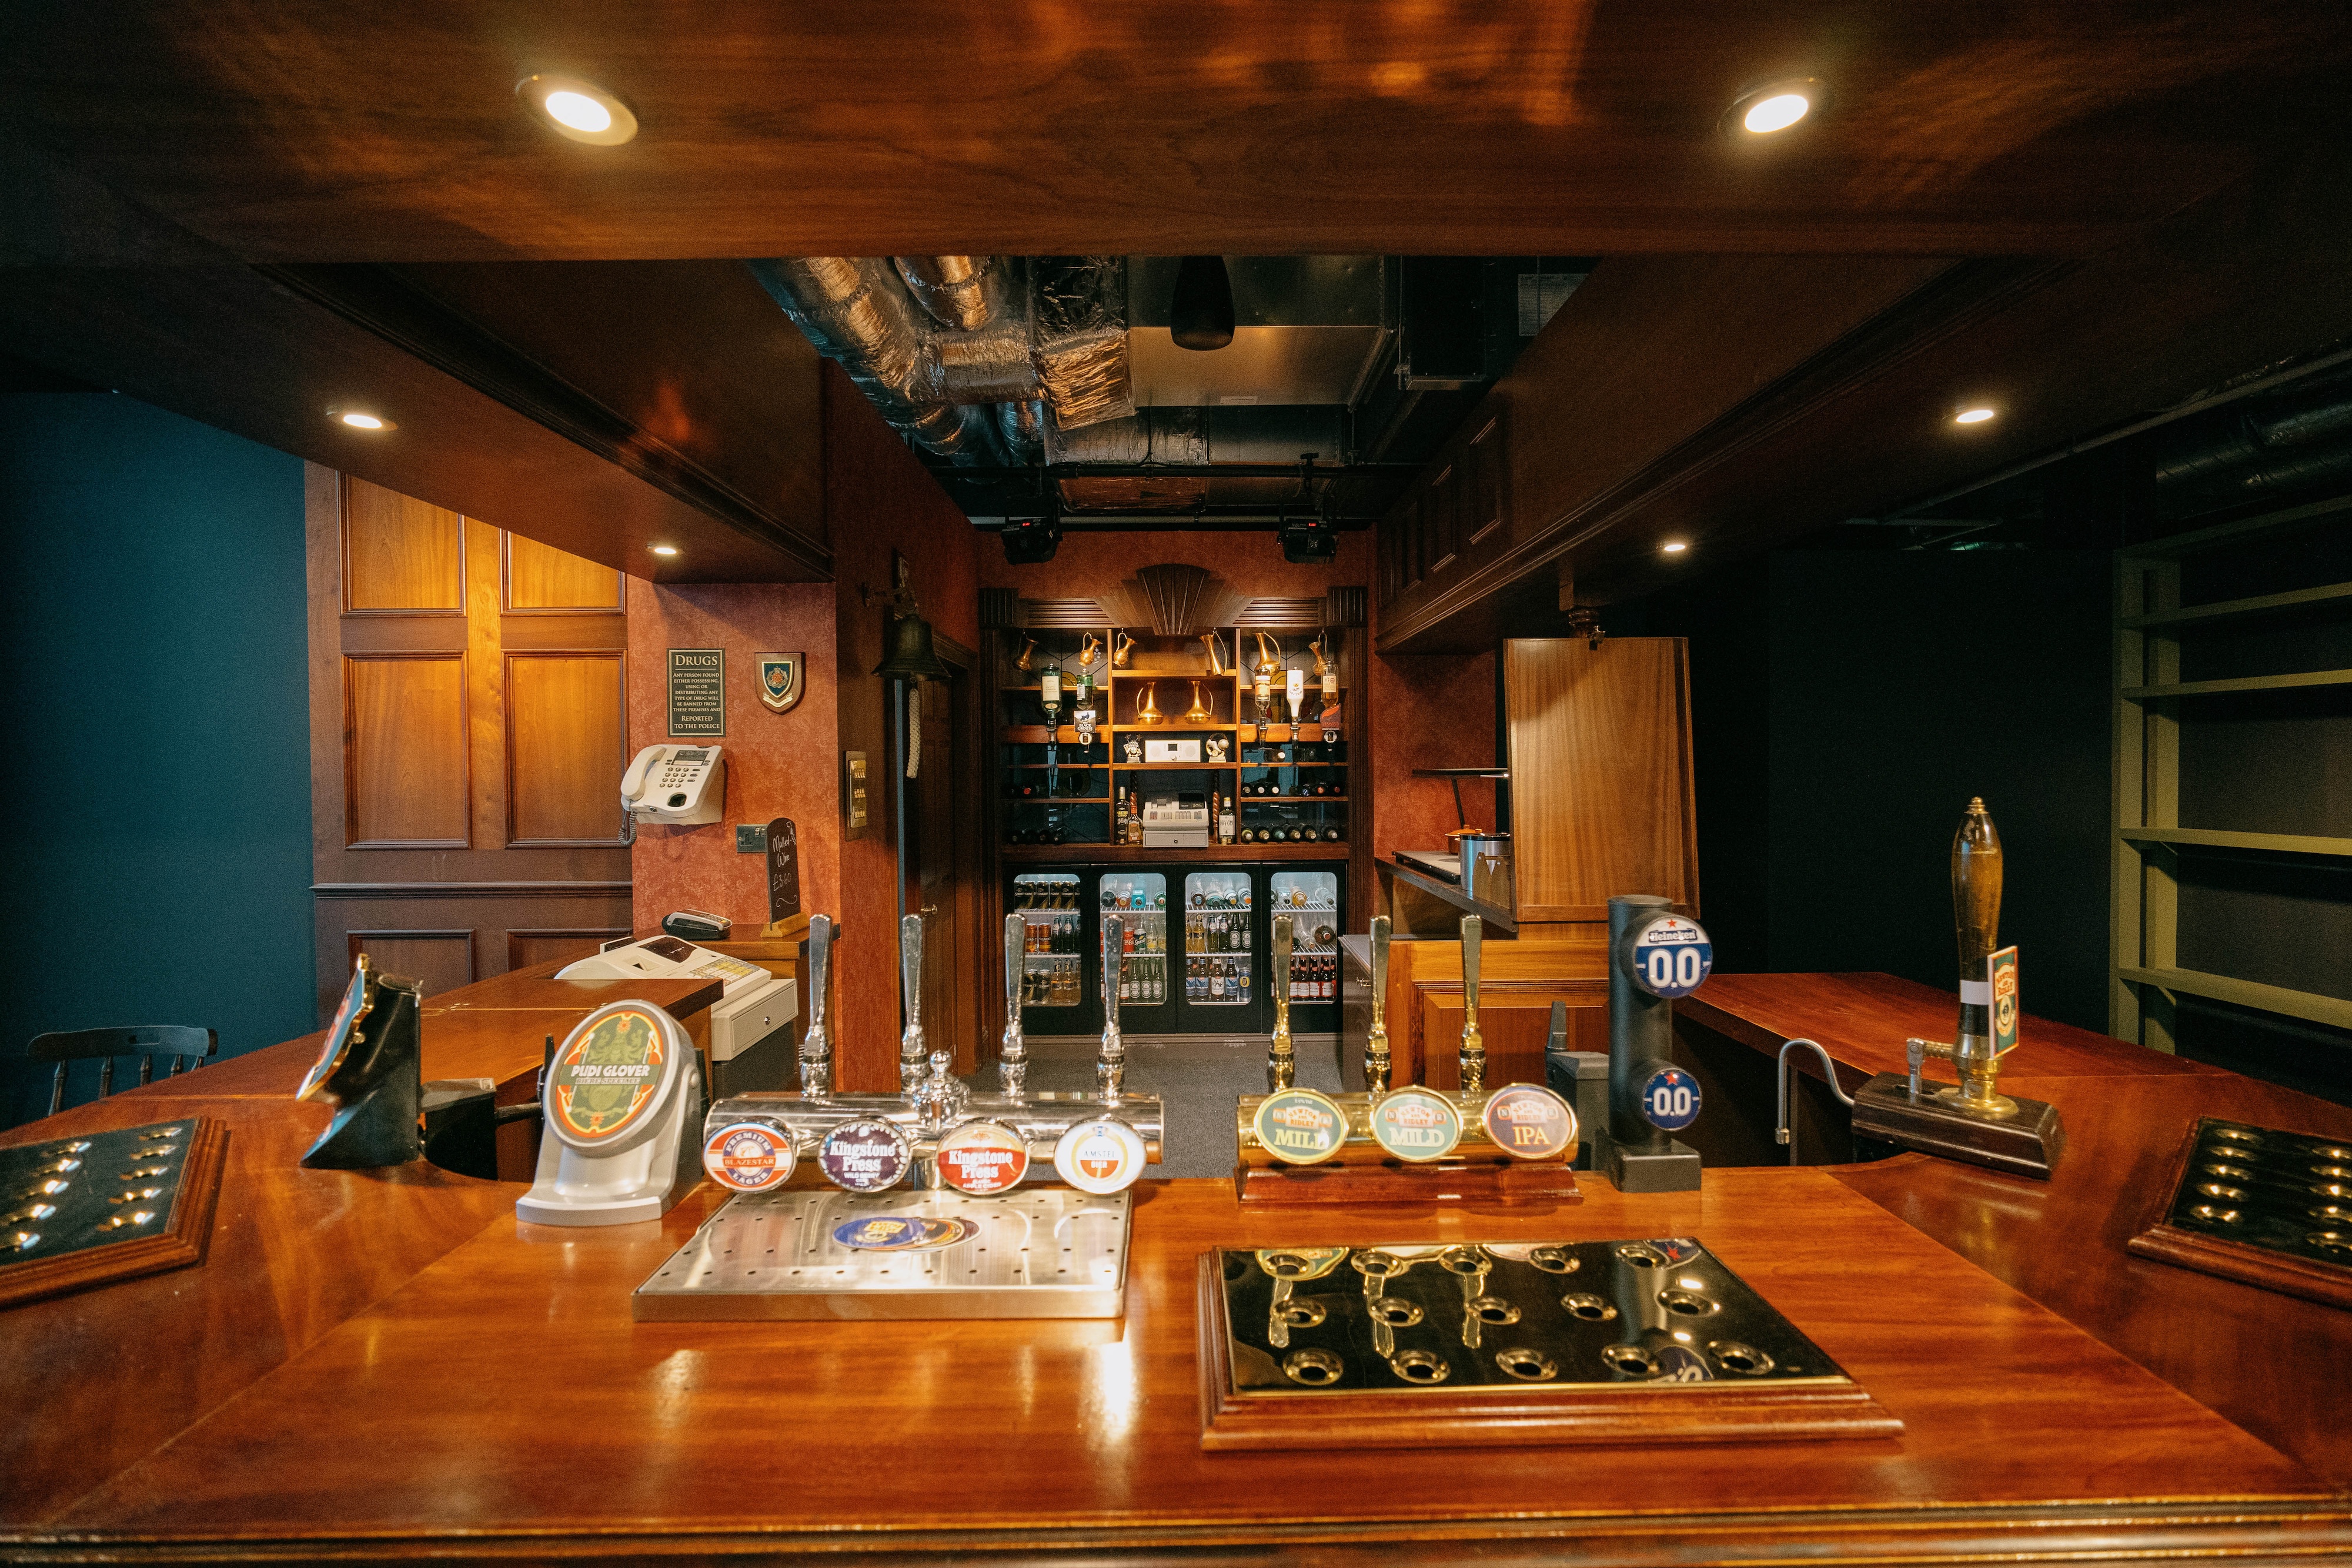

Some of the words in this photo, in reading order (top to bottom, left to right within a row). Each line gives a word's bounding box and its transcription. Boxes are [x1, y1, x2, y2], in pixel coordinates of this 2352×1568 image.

[675, 655, 717, 666] DRUGS
[773, 835, 790, 852] Mulled
[777, 852, 790, 867] Wine
[1649, 931, 1696, 941] Heineken
[1648, 947, 1701, 988] 0.0
[570, 1065, 602, 1076] PUDI
[603, 1065, 650, 1076] GLOVER
[1653, 1086, 1692, 1116] 0.0
[1288, 1109, 1317, 1119] NEWTON
[726, 1132, 771, 1152] PREMIUM
[1389, 1127, 1445, 1147] MILD
[1513, 1126, 1551, 1145] IPA
[830, 1141, 896, 1159] Kingstone
[948, 1149, 1014, 1166] Kingstone
[843, 1156, 882, 1172] Press
[961, 1165, 999, 1179] Press
[733, 1172, 767, 1185] LAGER
